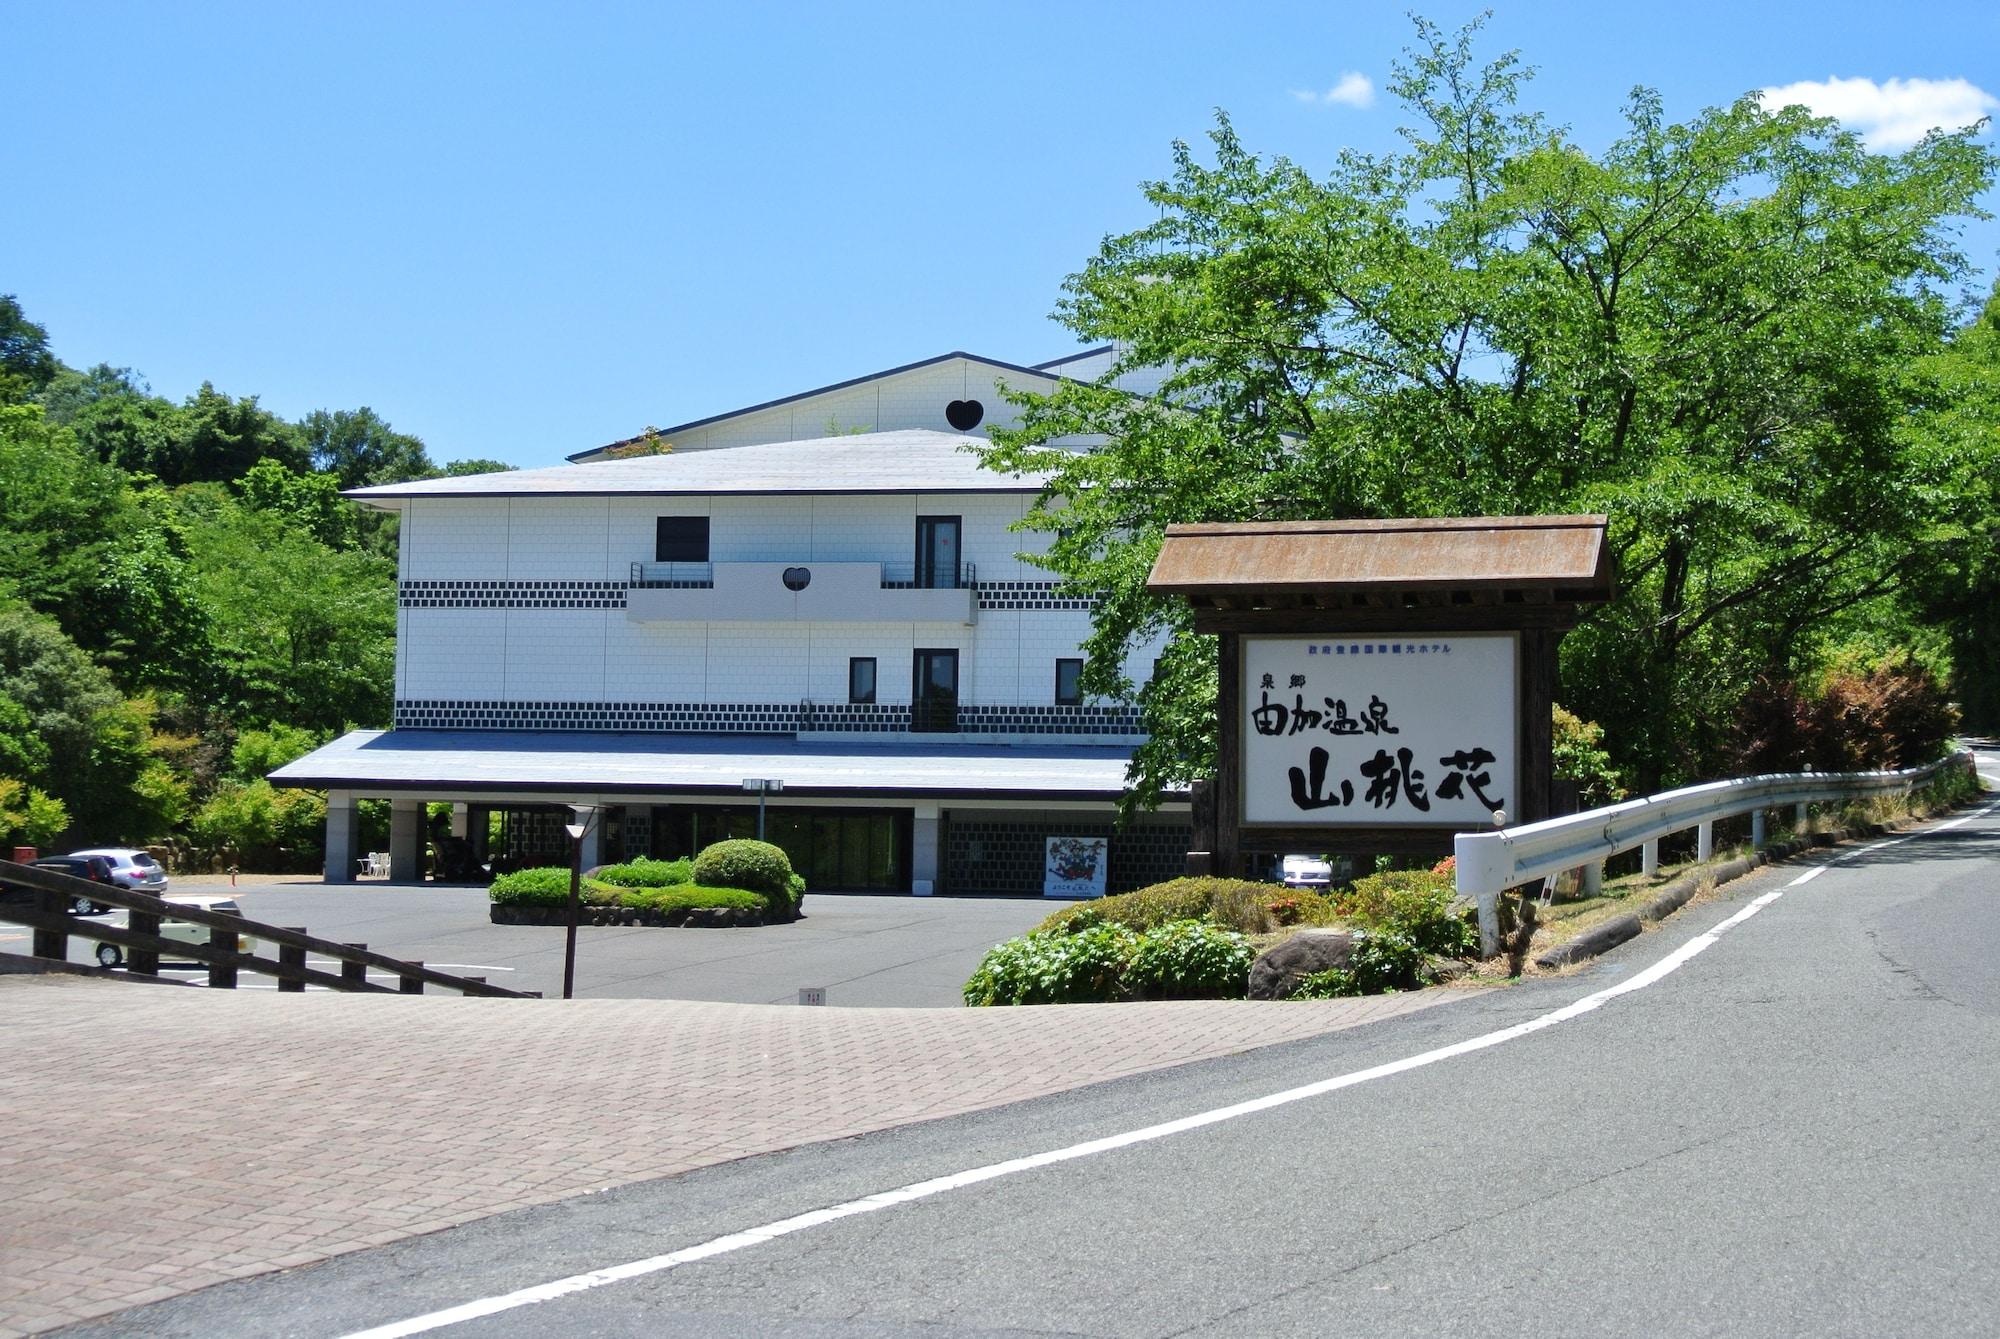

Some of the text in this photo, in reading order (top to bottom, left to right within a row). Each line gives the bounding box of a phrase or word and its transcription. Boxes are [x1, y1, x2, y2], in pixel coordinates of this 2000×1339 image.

[1260, 673, 1306, 689] 泉郷
[1251, 691, 1399, 736] 由加温泉
[1288, 746, 1504, 812] 山桃花
